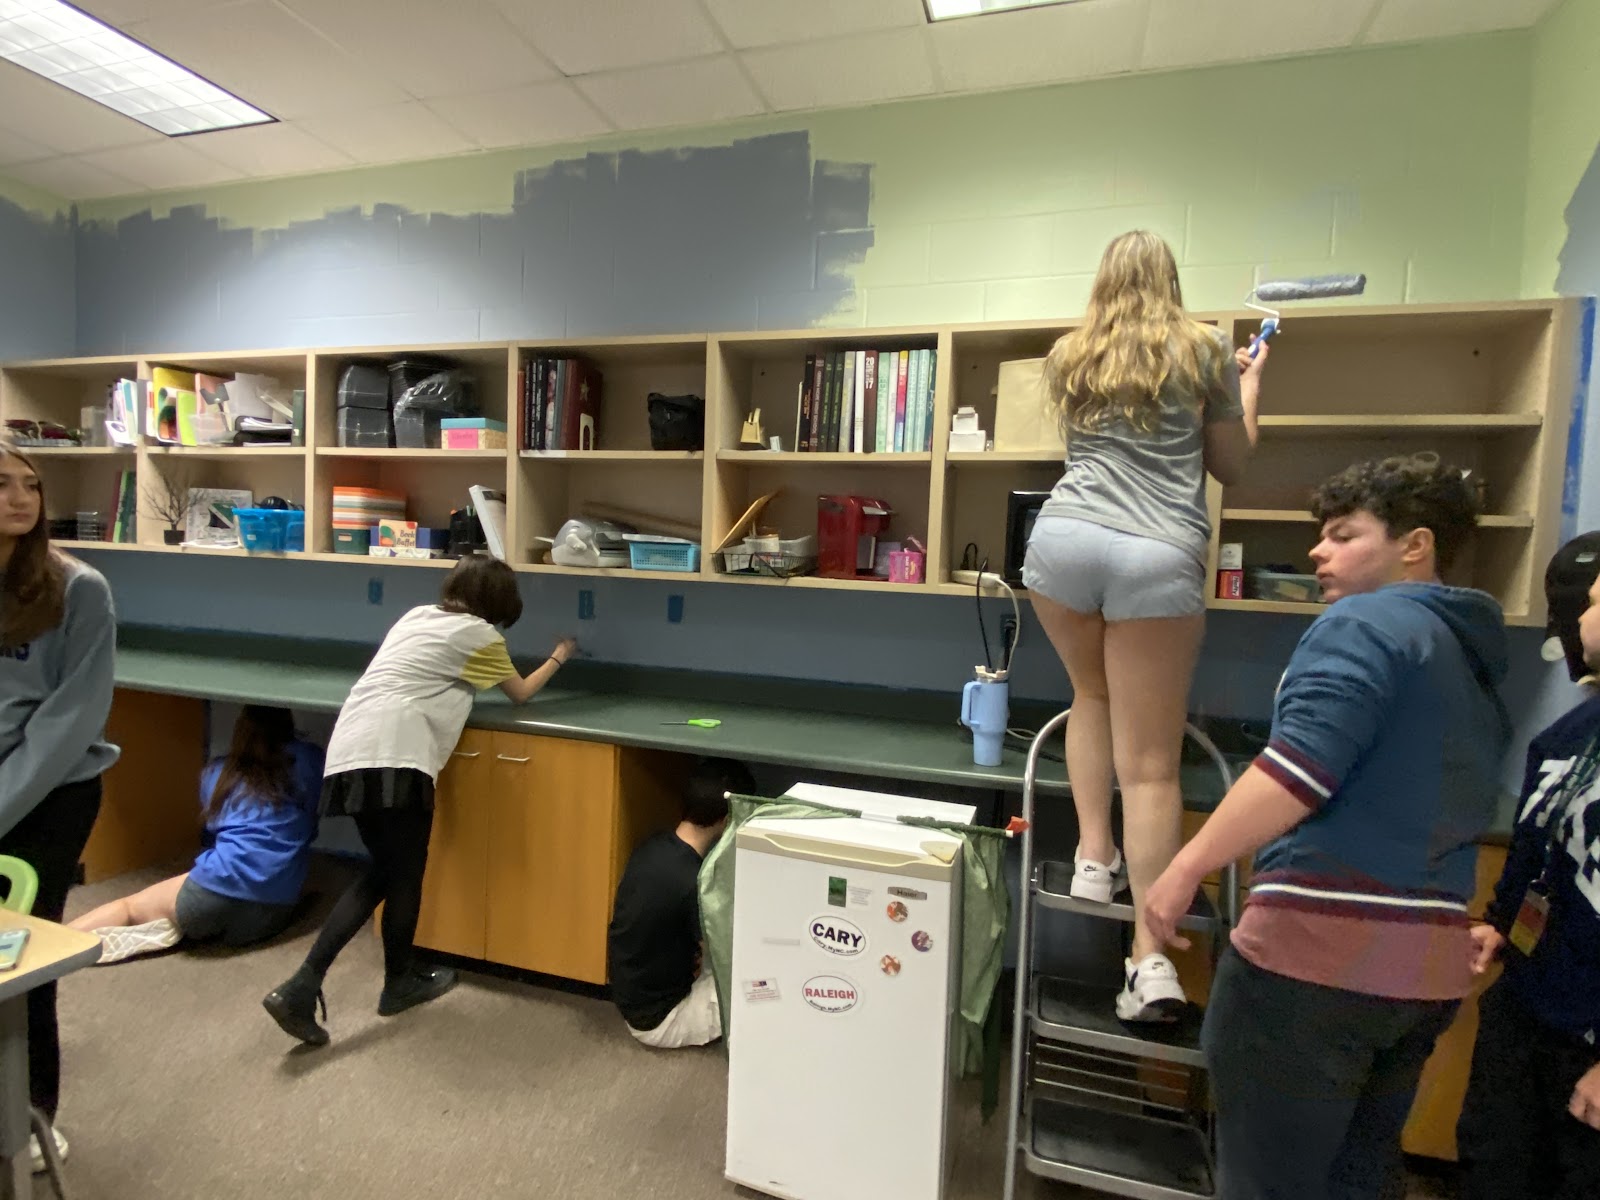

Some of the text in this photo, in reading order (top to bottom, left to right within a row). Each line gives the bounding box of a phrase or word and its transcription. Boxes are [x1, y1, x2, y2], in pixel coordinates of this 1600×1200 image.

[866, 357, 874, 366] 20
[865, 380, 873, 389] 17
[896, 890, 916, 898] Haier
[813, 923, 862, 948] CARY
[805, 988, 855, 999] RALEIGH
